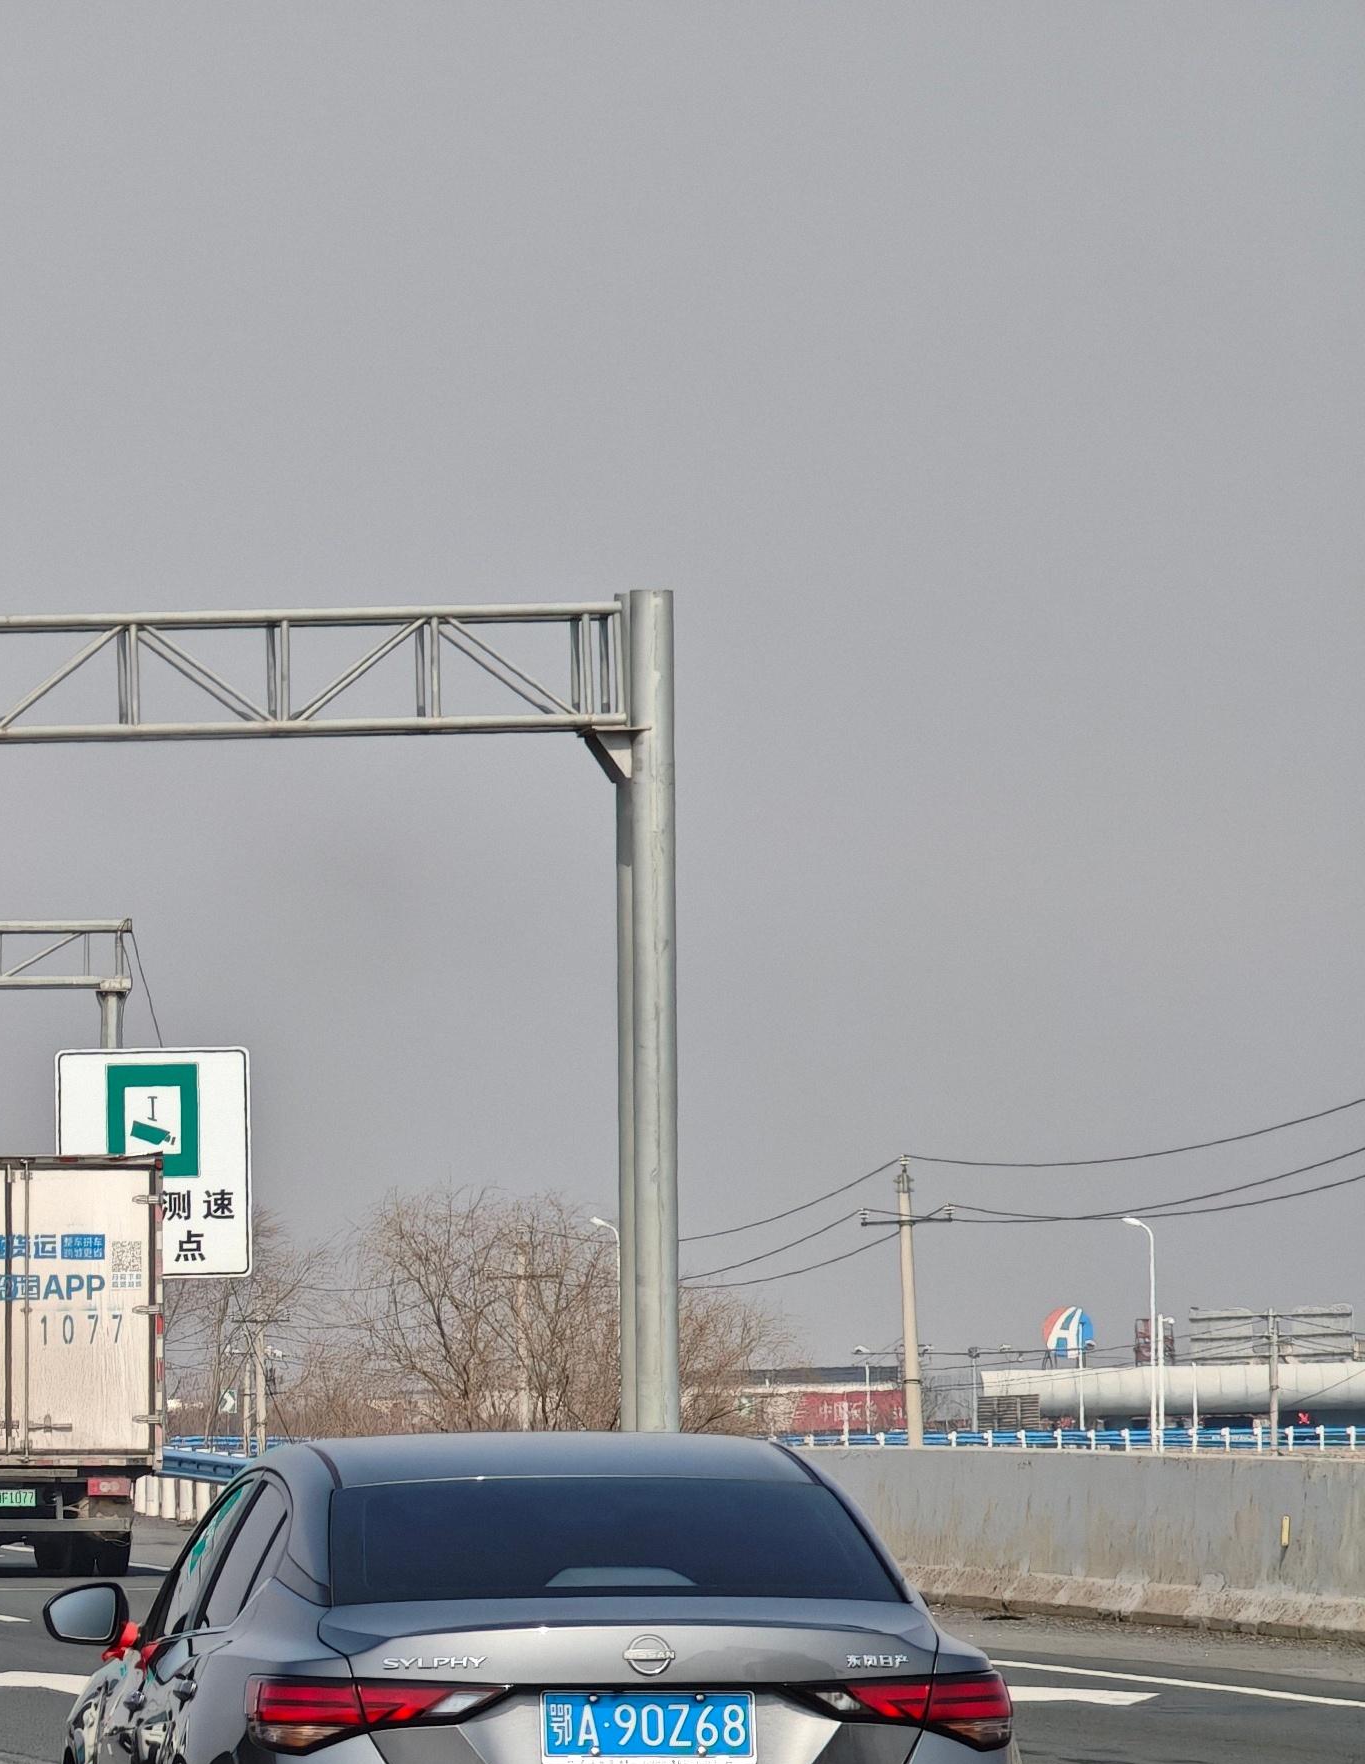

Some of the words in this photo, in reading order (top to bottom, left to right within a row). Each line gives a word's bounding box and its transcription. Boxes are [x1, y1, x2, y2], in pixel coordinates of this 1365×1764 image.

[163, 1189, 234, 1221] 测速
[174, 1230, 206, 1262] 点
[623, 1648, 675, 1660] NISSAN
[846, 1654, 909, 1669] 东风日产
[382, 1656, 487, 1670] SYLPHY
